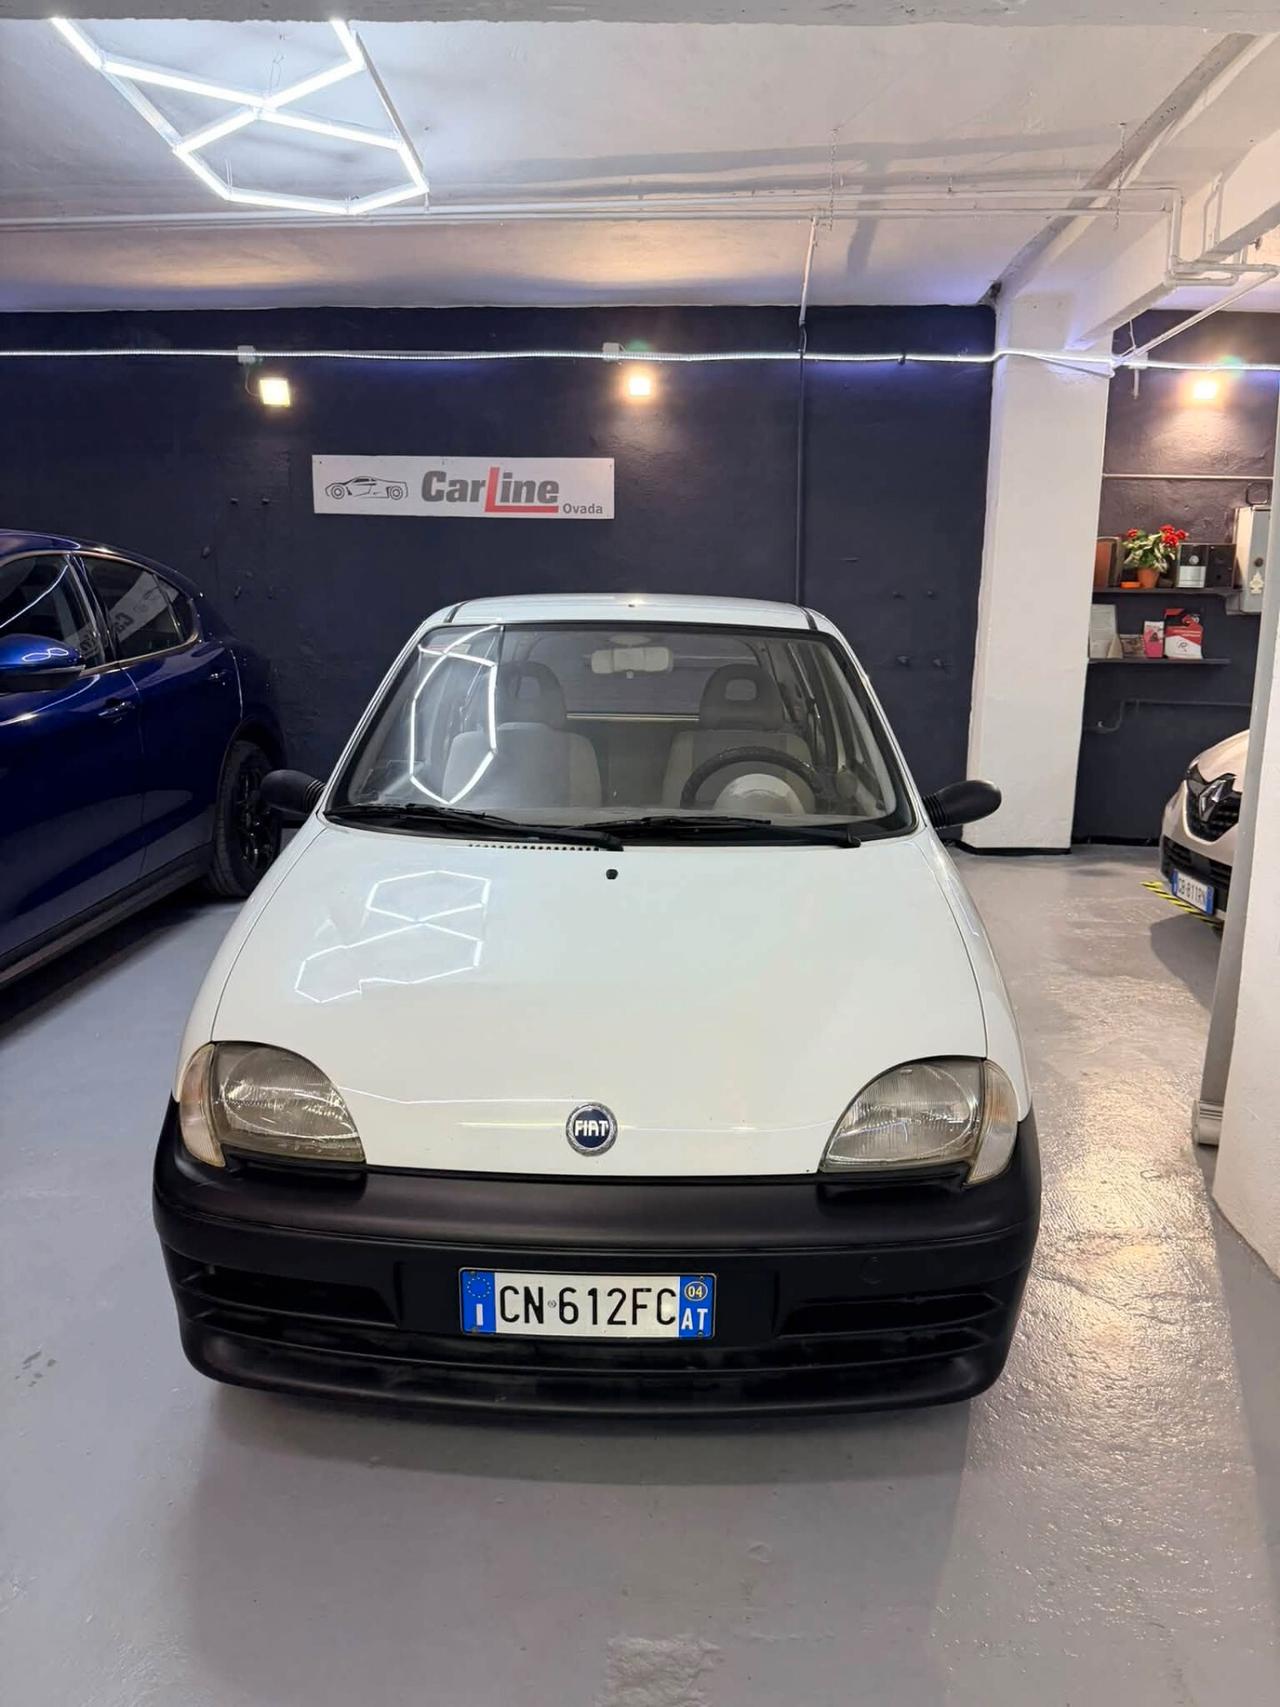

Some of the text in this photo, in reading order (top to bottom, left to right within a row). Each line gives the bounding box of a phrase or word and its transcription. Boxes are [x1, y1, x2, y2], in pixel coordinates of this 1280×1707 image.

[420, 466, 559, 513] CarLine
[562, 503, 603, 515] Ovada
[574, 1120, 609, 1137] FIAT
[687, 1285, 703, 1298] 04
[500, 1286, 544, 1325] CN
[558, 1287, 676, 1326] 612FC
[681, 1307, 709, 1331] AT
